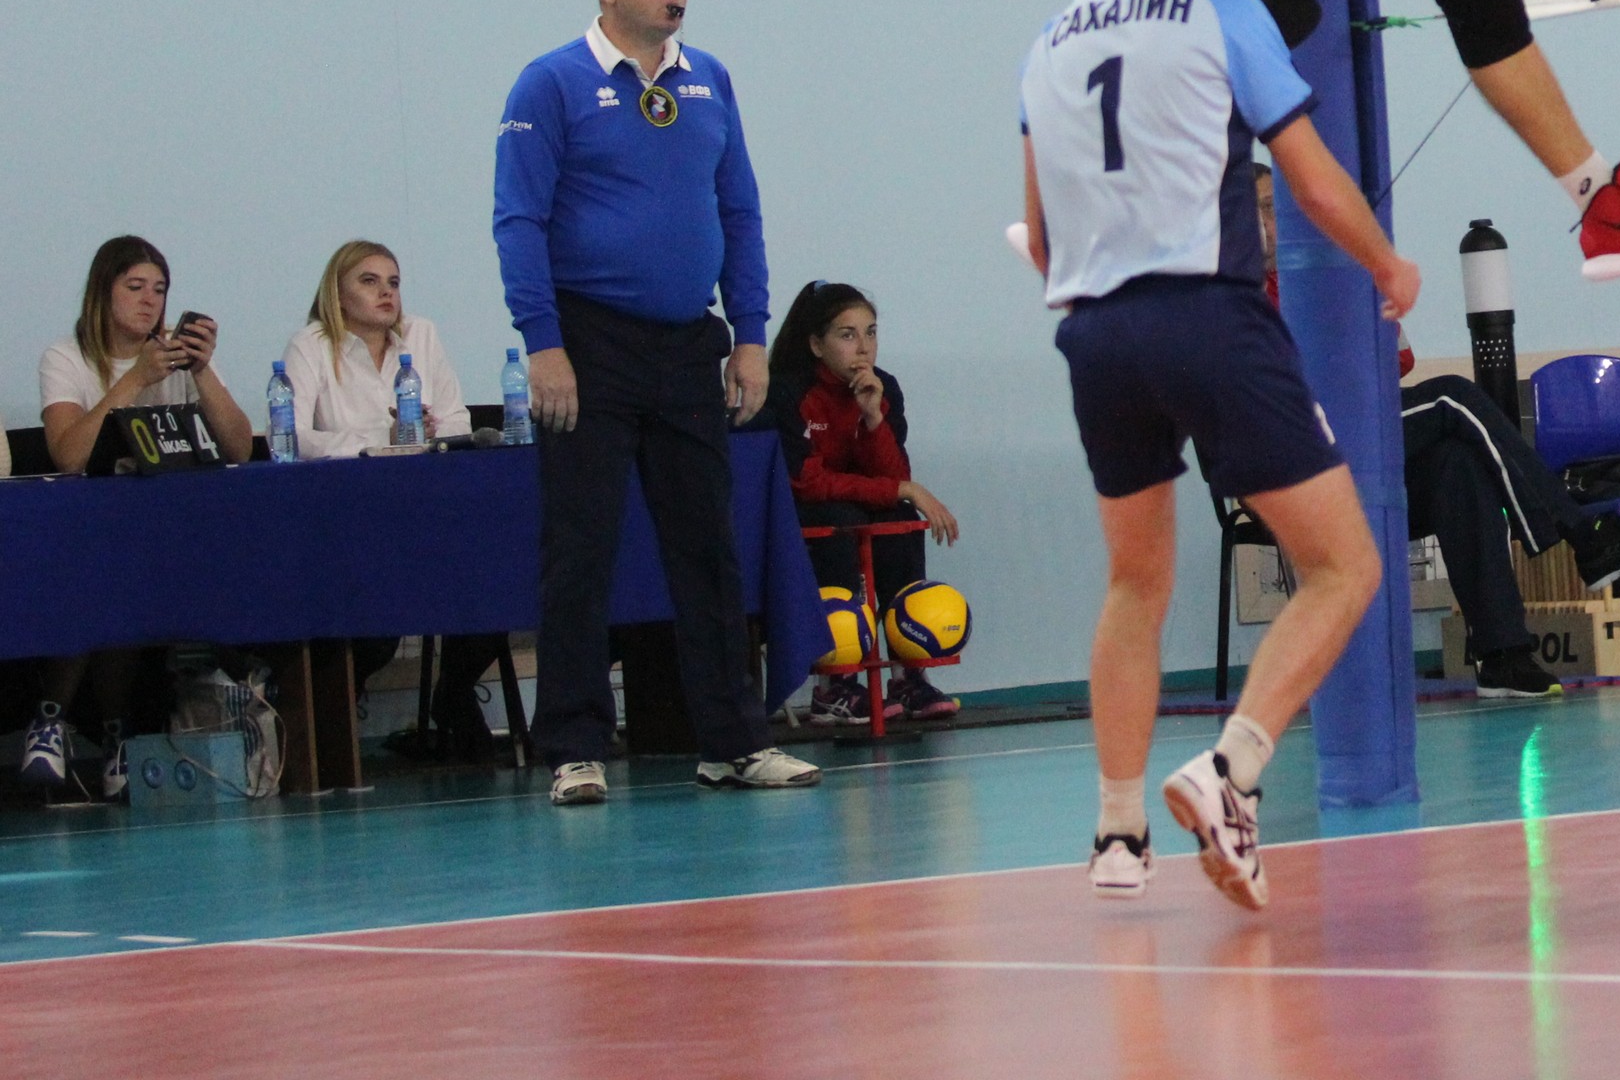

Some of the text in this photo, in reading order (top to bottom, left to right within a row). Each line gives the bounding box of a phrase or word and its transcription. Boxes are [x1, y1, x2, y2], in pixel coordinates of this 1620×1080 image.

[1087, 54, 1125, 172] 1
[131, 418, 160, 464] 0
[152, 412, 178, 433] 2 0
[193, 413, 220, 459] 4
[900, 620, 928, 644] MIKASA
